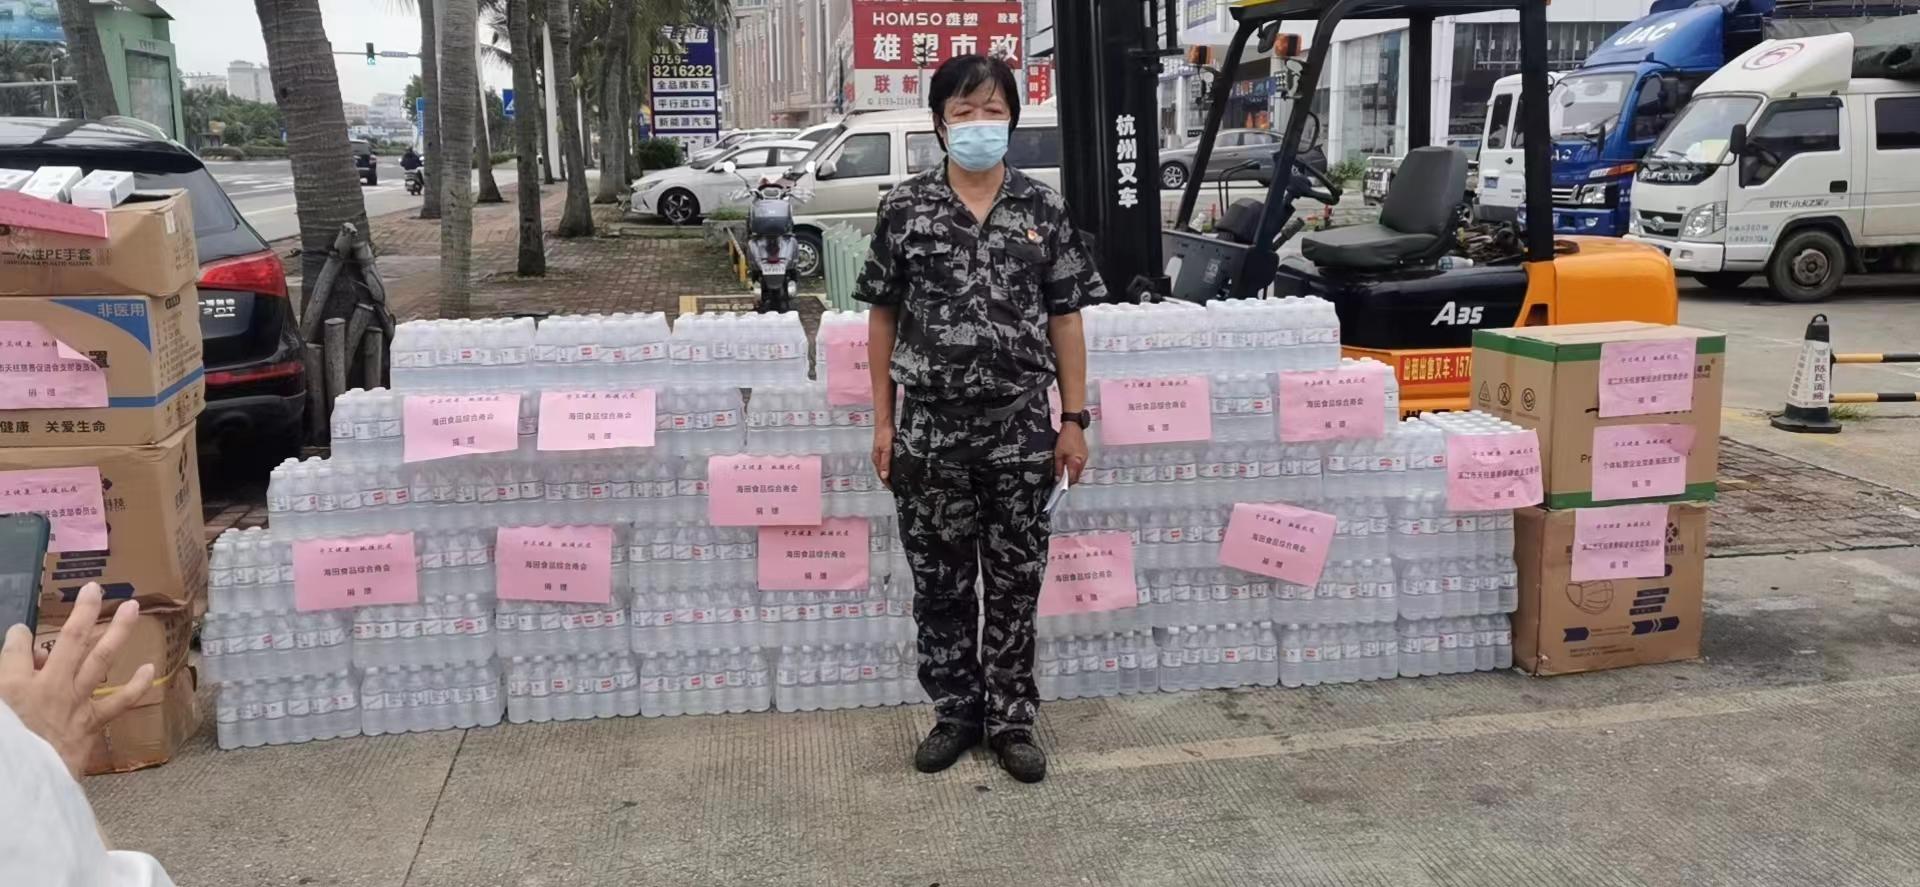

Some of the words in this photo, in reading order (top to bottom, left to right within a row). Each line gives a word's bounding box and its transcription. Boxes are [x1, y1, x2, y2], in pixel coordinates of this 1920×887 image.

[872, 12, 943, 26] HOMSO
[1614, 22, 1677, 46] JAC
[873, 32, 1020, 63] 雄塑市政
[653, 65, 713, 77] 8216232
[657, 81, 711, 90] 全品牌新车
[658, 99, 712, 109] 平行进口车
[659, 117, 712, 127] 新能源汽车
[1116, 114, 1138, 208] 杭州叉车
[1550, 149, 1572, 161] AC
[2, 247, 92, 261] 一次性PE手套
[98, 301, 146, 318] 非医用
[1431, 301, 1485, 325] A35
[46, 420, 106, 434] 关爱生命
[735, 484, 799, 494] 海田食品综合商会
[785, 550, 847, 559] 海田食品综合商会
